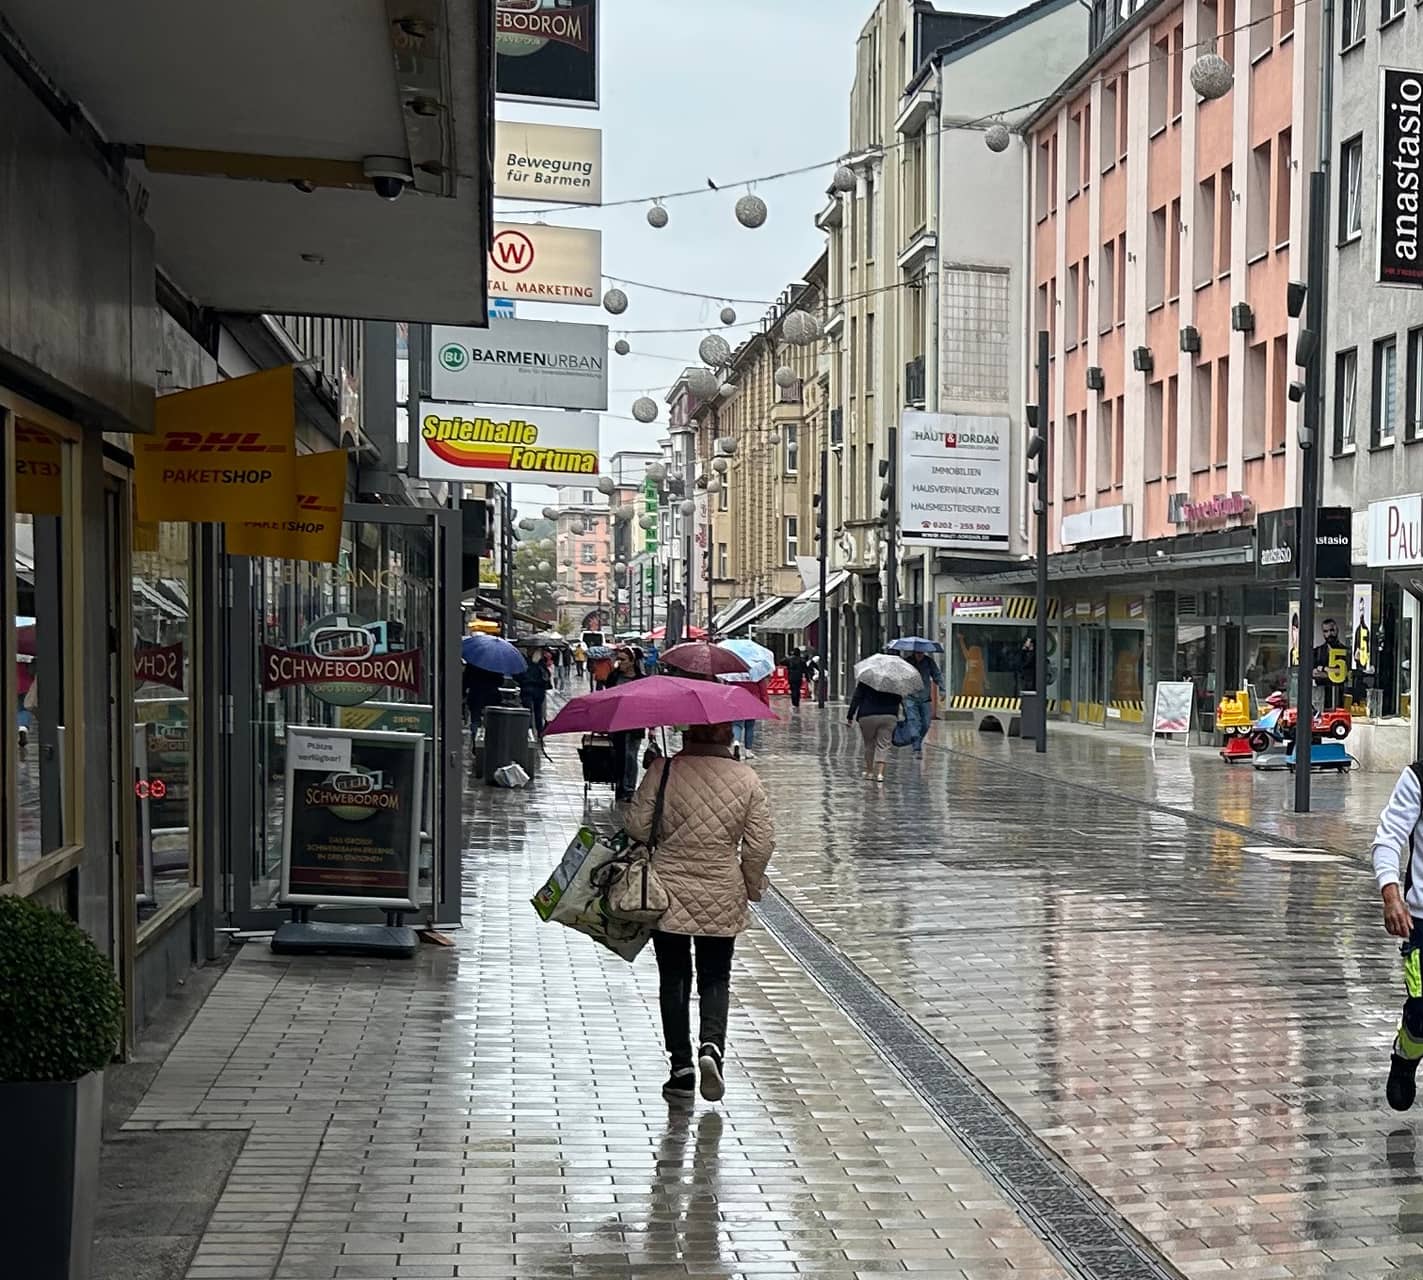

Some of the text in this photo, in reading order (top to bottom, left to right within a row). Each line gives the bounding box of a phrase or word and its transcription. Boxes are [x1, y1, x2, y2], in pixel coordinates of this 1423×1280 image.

[496, 12, 581, 40] EBODROM
[507, 153, 593, 176] Bewegung
[1391, 78, 1422, 260] anastasio
[507, 169, 591, 187] für Barmen
[498, 242, 526, 264] W
[487, 280, 593, 298] TAL MARKETING
[472, 348, 602, 370] BARMENURBAN
[422, 415, 538, 445] Spielhalle
[915, 431, 944, 441] HAUT
[958, 433, 1000, 444] JORDAN
[164, 432, 270, 453] DHL
[509, 446, 598, 475] Fortuna
[932, 466, 981, 476] IMMOBILIEN
[162, 469, 272, 484] PAKETSHOP
[912, 484, 1000, 497] HAUSVERWALTUNGEN
[911, 502, 1000, 514] HAUSMEISTERSERVICE
[1315, 535, 1348, 545] stasio
[269, 654, 415, 685] SCHWEBODROM
[1328, 648, 1347, 683] 5
[305, 788, 400, 809] SCHWEBODROM
